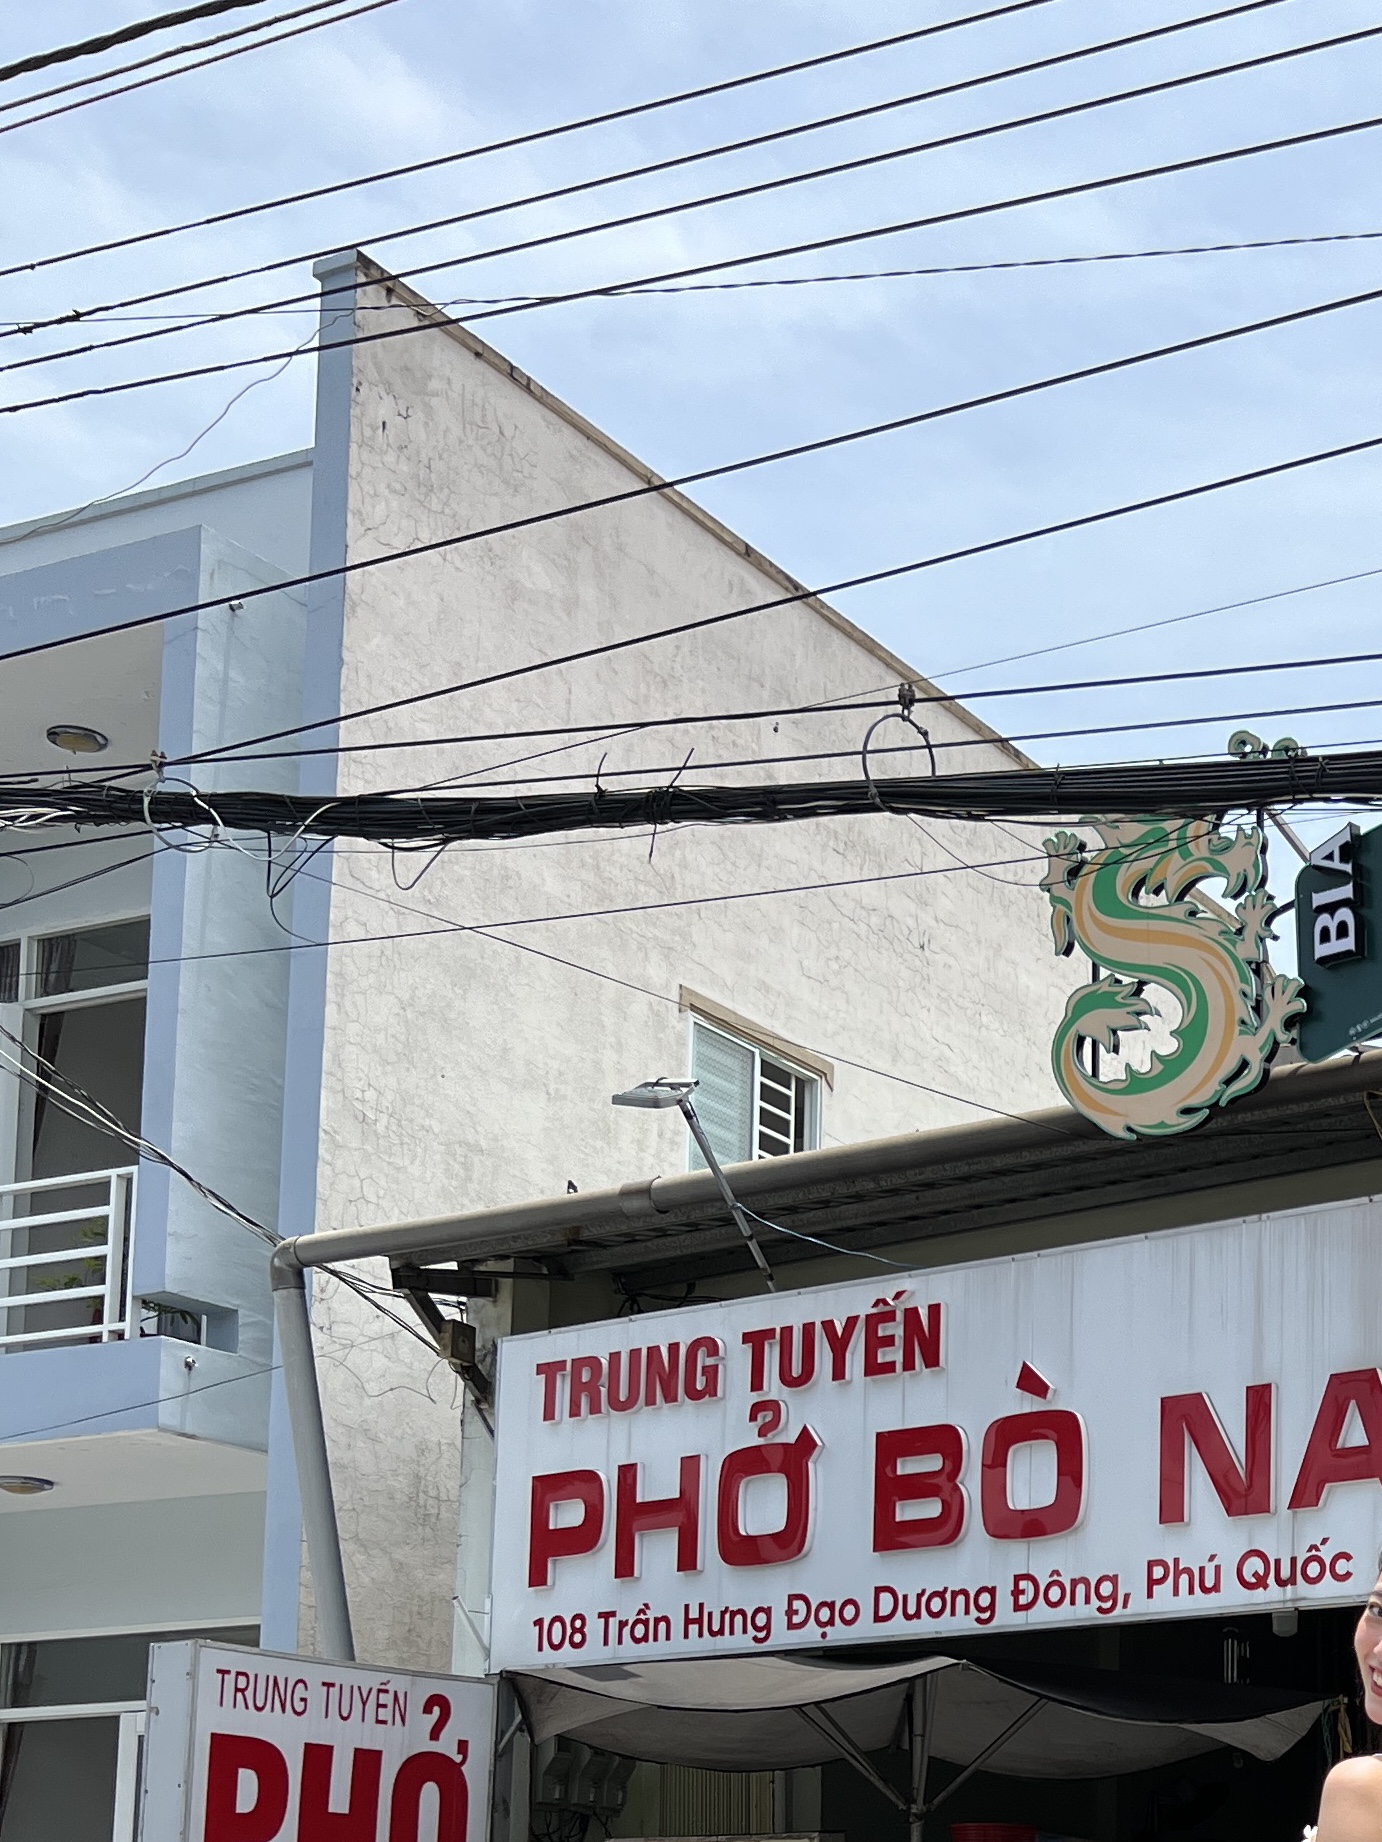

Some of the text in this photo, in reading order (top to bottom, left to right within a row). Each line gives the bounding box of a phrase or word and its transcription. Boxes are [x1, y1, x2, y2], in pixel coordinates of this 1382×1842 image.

[1312, 823, 1361, 965] BIA
[535, 1289, 944, 1422] TRUNG TUYẾN
[528, 1400, 821, 1588] PHỞ
[872, 1360, 1085, 1554] BÒ
[533, 1537, 1354, 1652] 108 Trần Hưng Đạo Dương Đông, Phú Quốc
[216, 1668, 408, 1728] TRUNG TUYẾN
